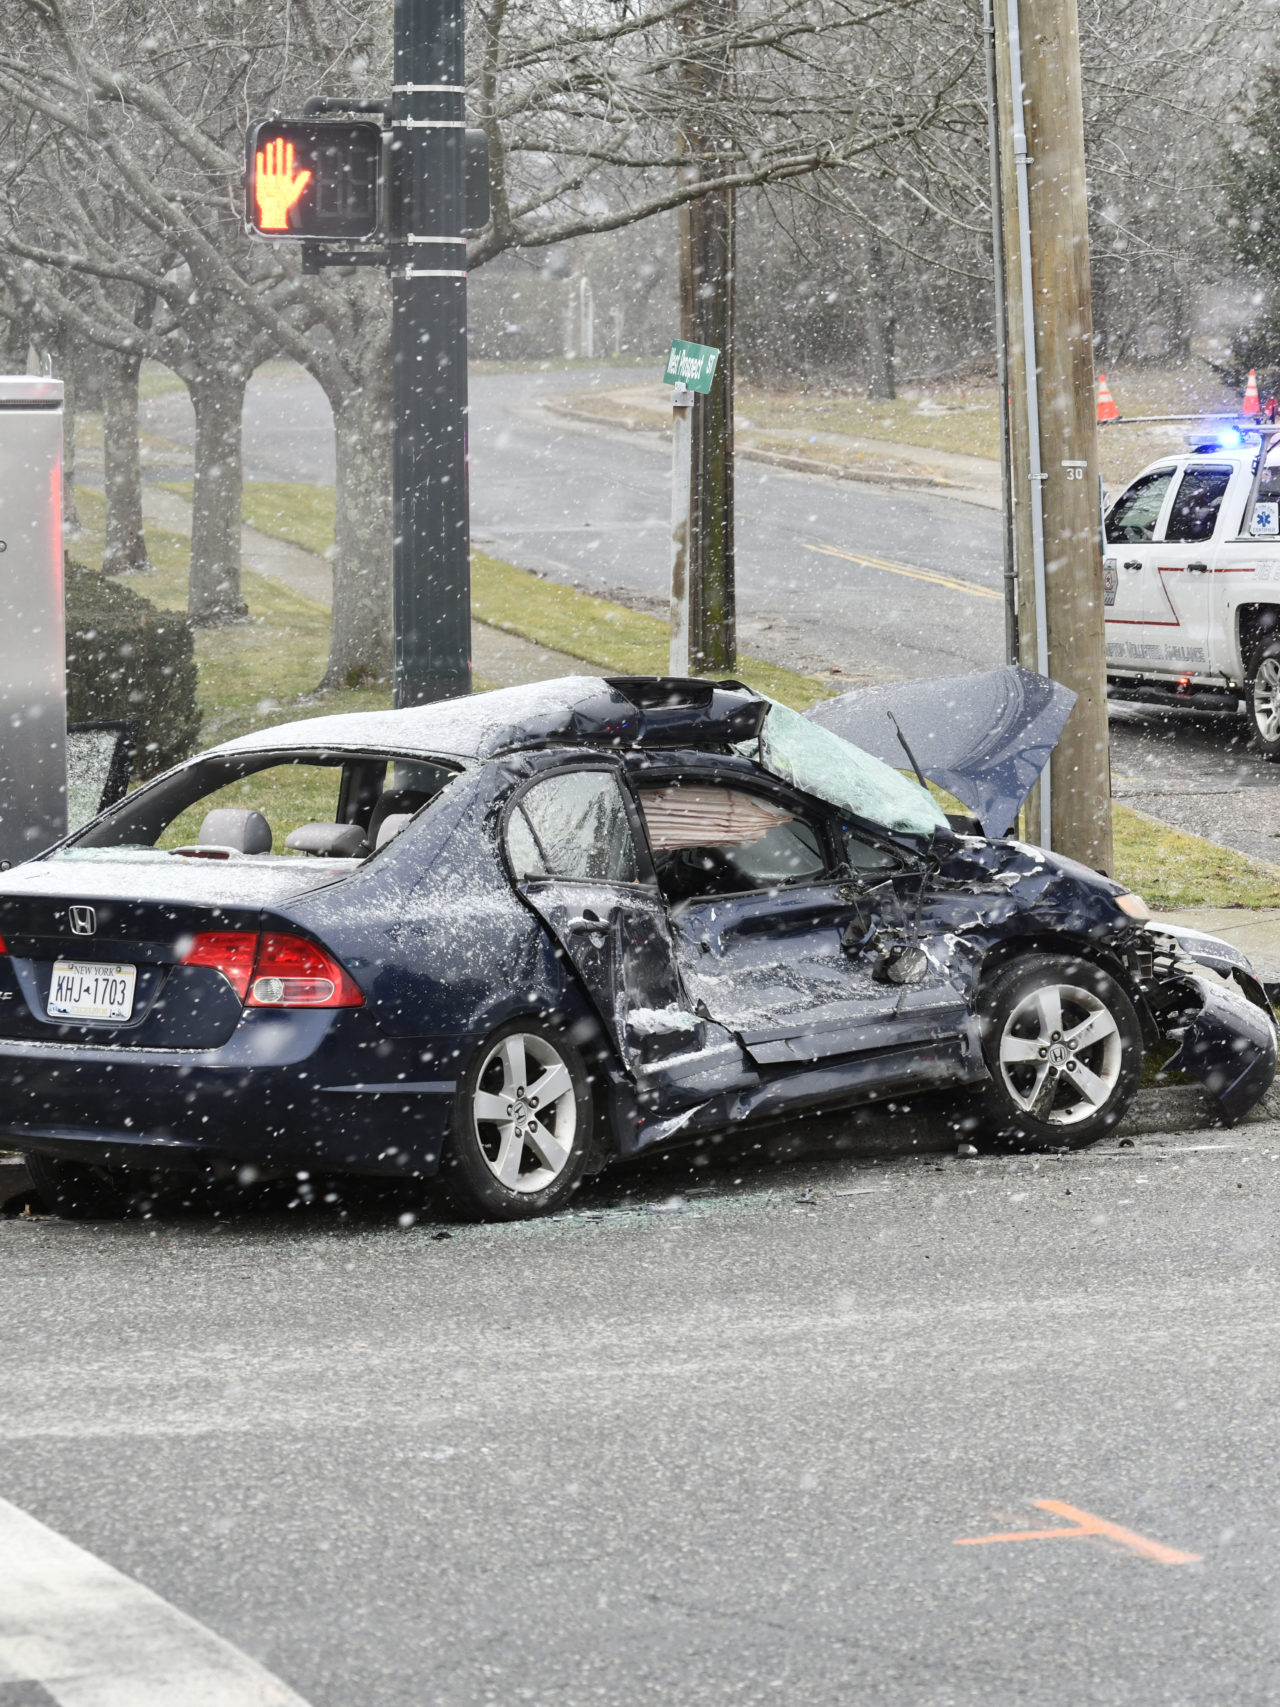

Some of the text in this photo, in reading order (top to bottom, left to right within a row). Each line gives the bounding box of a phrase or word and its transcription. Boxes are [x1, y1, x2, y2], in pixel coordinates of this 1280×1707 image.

[679, 349, 704, 383] Prospect
[1066, 468, 1083, 480] 30
[73, 965, 115, 977] NEW YORK
